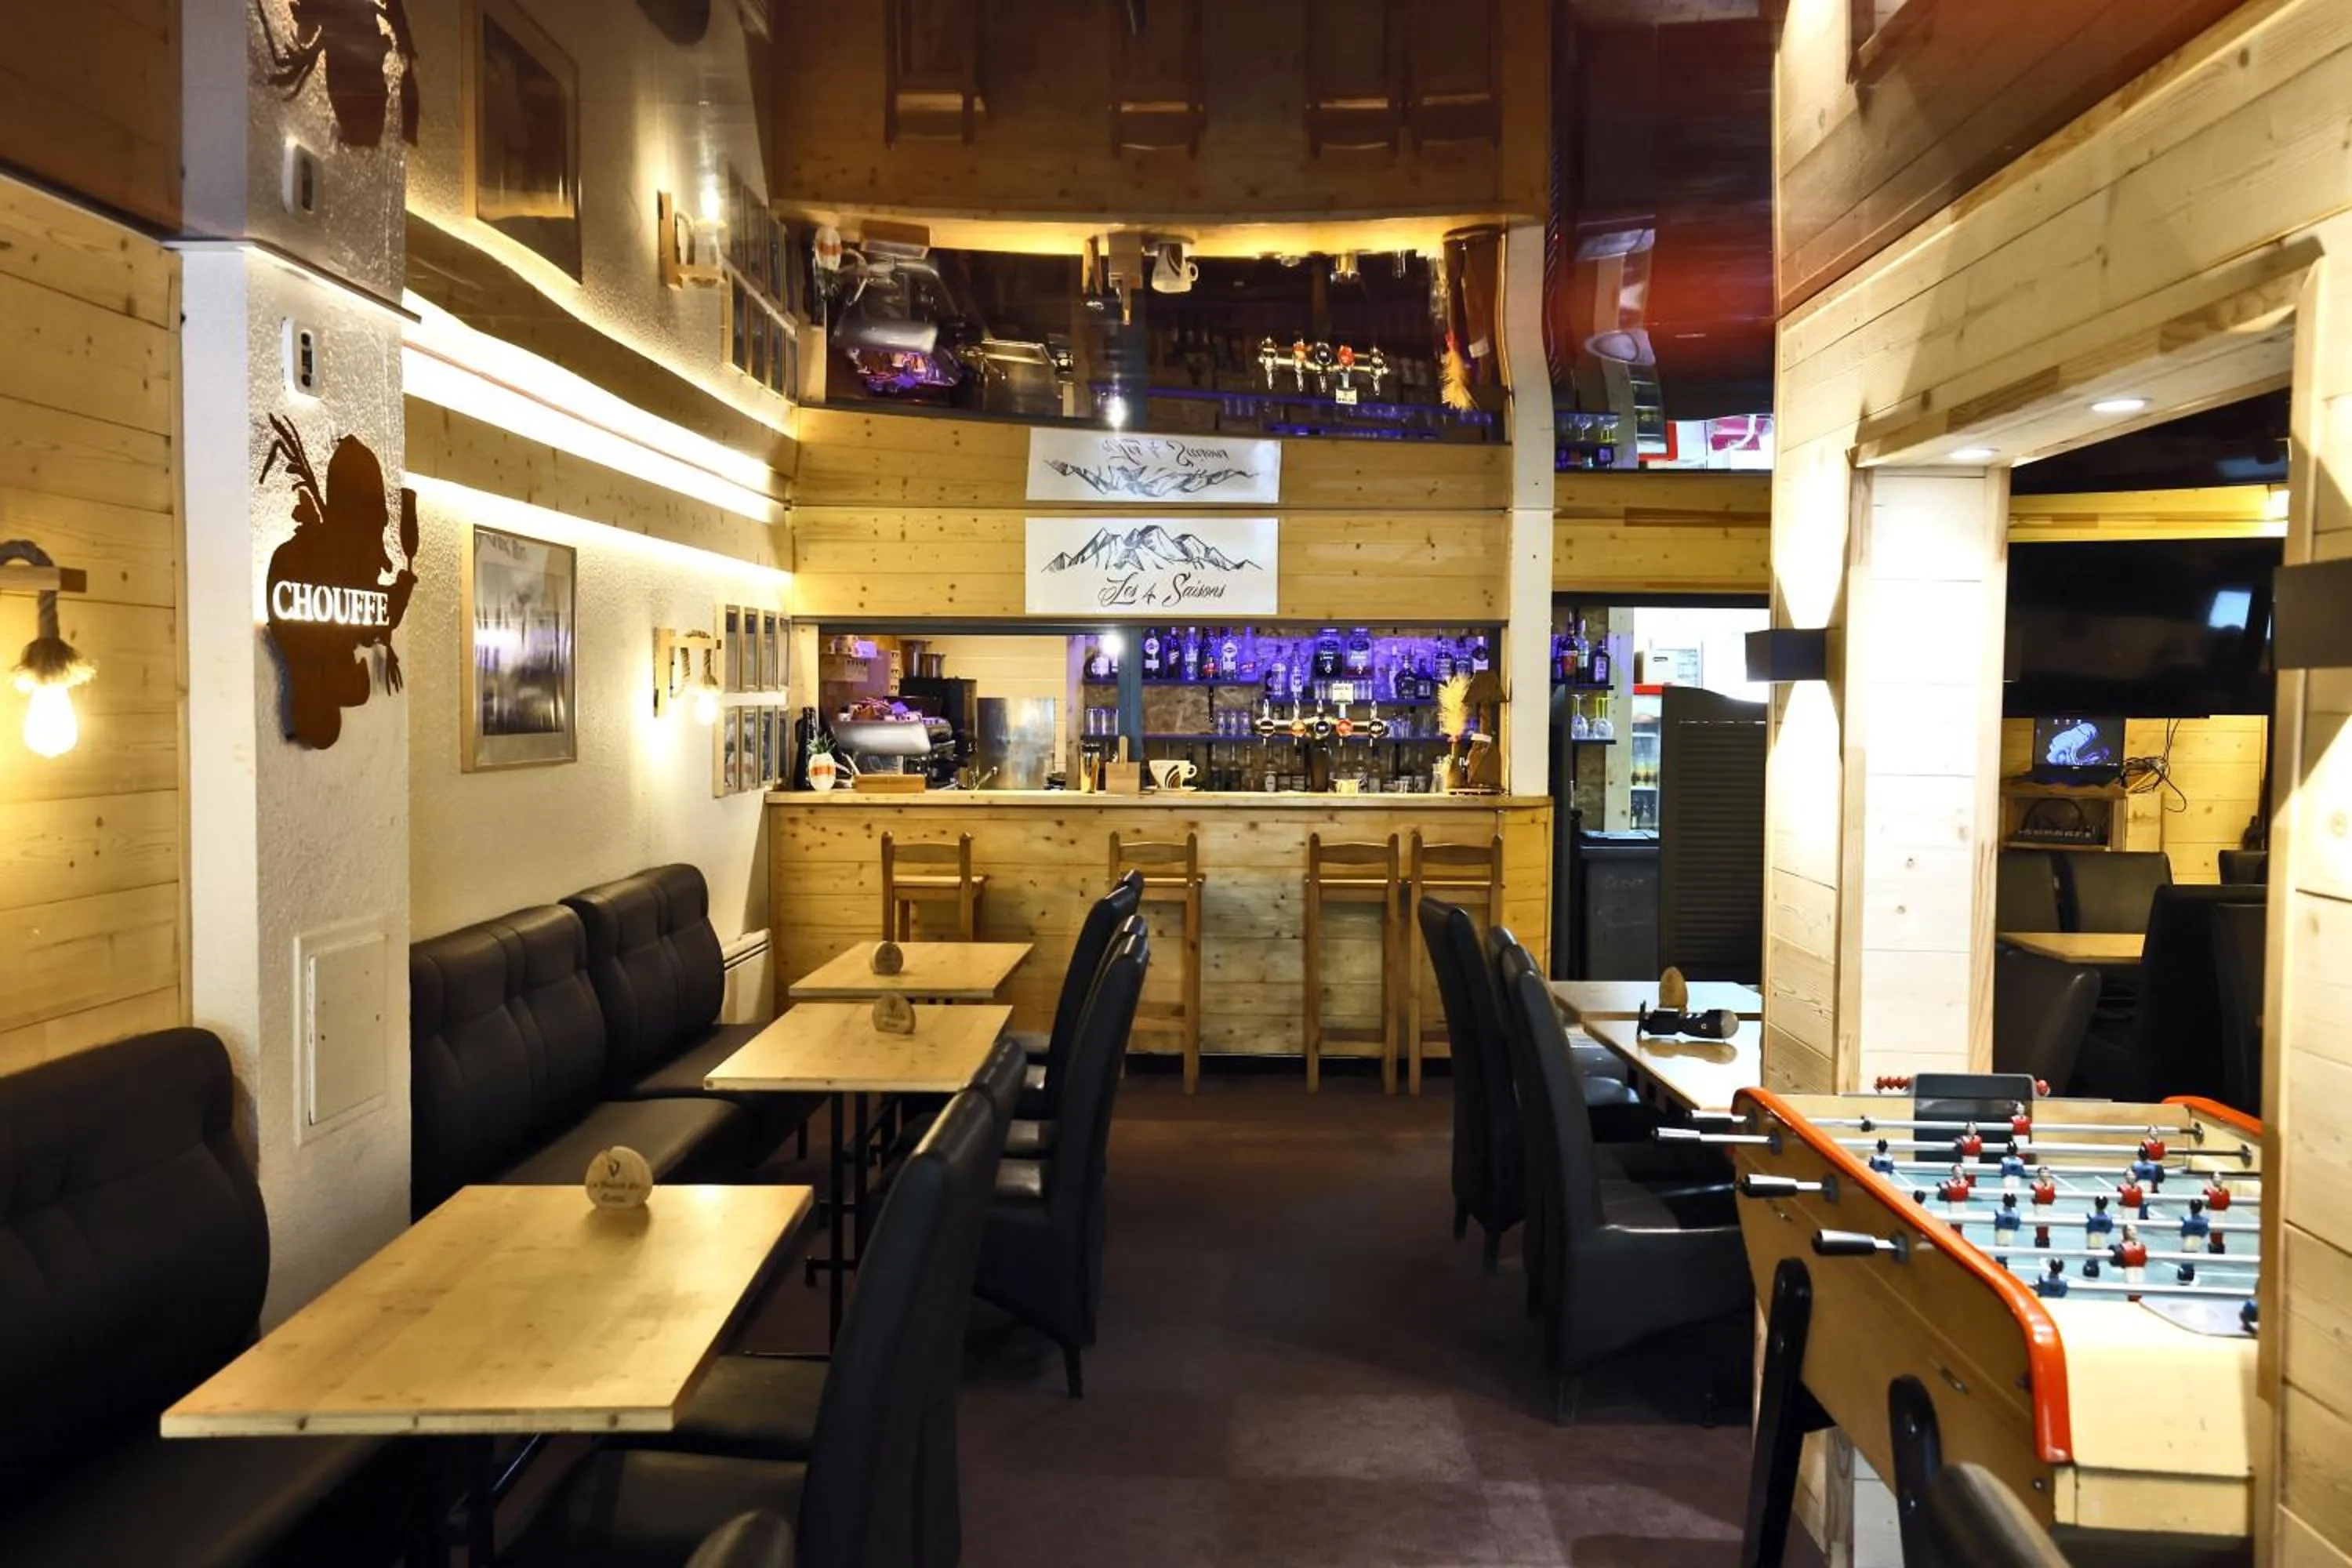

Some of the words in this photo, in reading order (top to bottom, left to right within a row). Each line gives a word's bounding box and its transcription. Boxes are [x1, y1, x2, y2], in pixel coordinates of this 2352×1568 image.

[273, 580, 390, 626] CHOUFFE
[1098, 572, 1139, 607] Les
[1142, 583, 1157, 605] 4
[1160, 572, 1227, 607] Saisons
